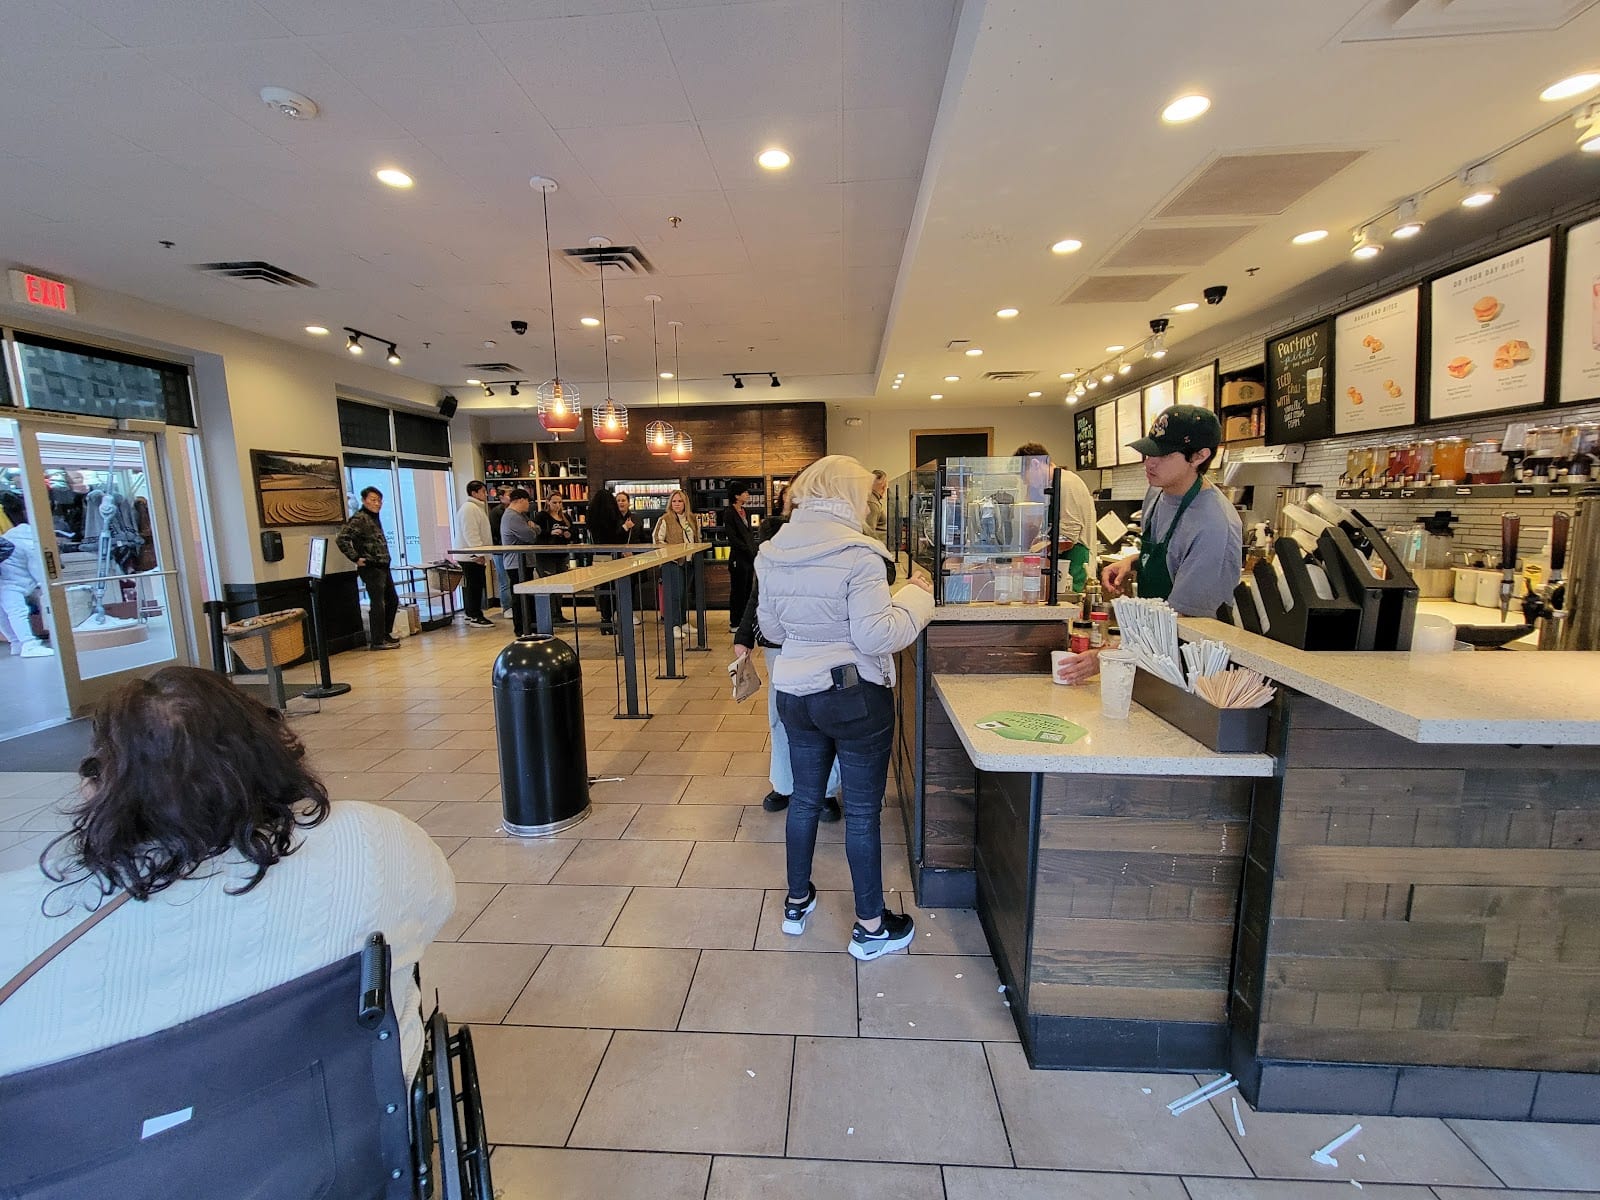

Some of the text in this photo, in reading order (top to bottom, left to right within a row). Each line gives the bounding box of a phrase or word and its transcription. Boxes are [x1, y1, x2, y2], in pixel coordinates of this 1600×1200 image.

[25, 274, 67, 311] EXIT
[1278, 332, 1318, 358] Partner
[1276, 372, 1292, 390] ICED
